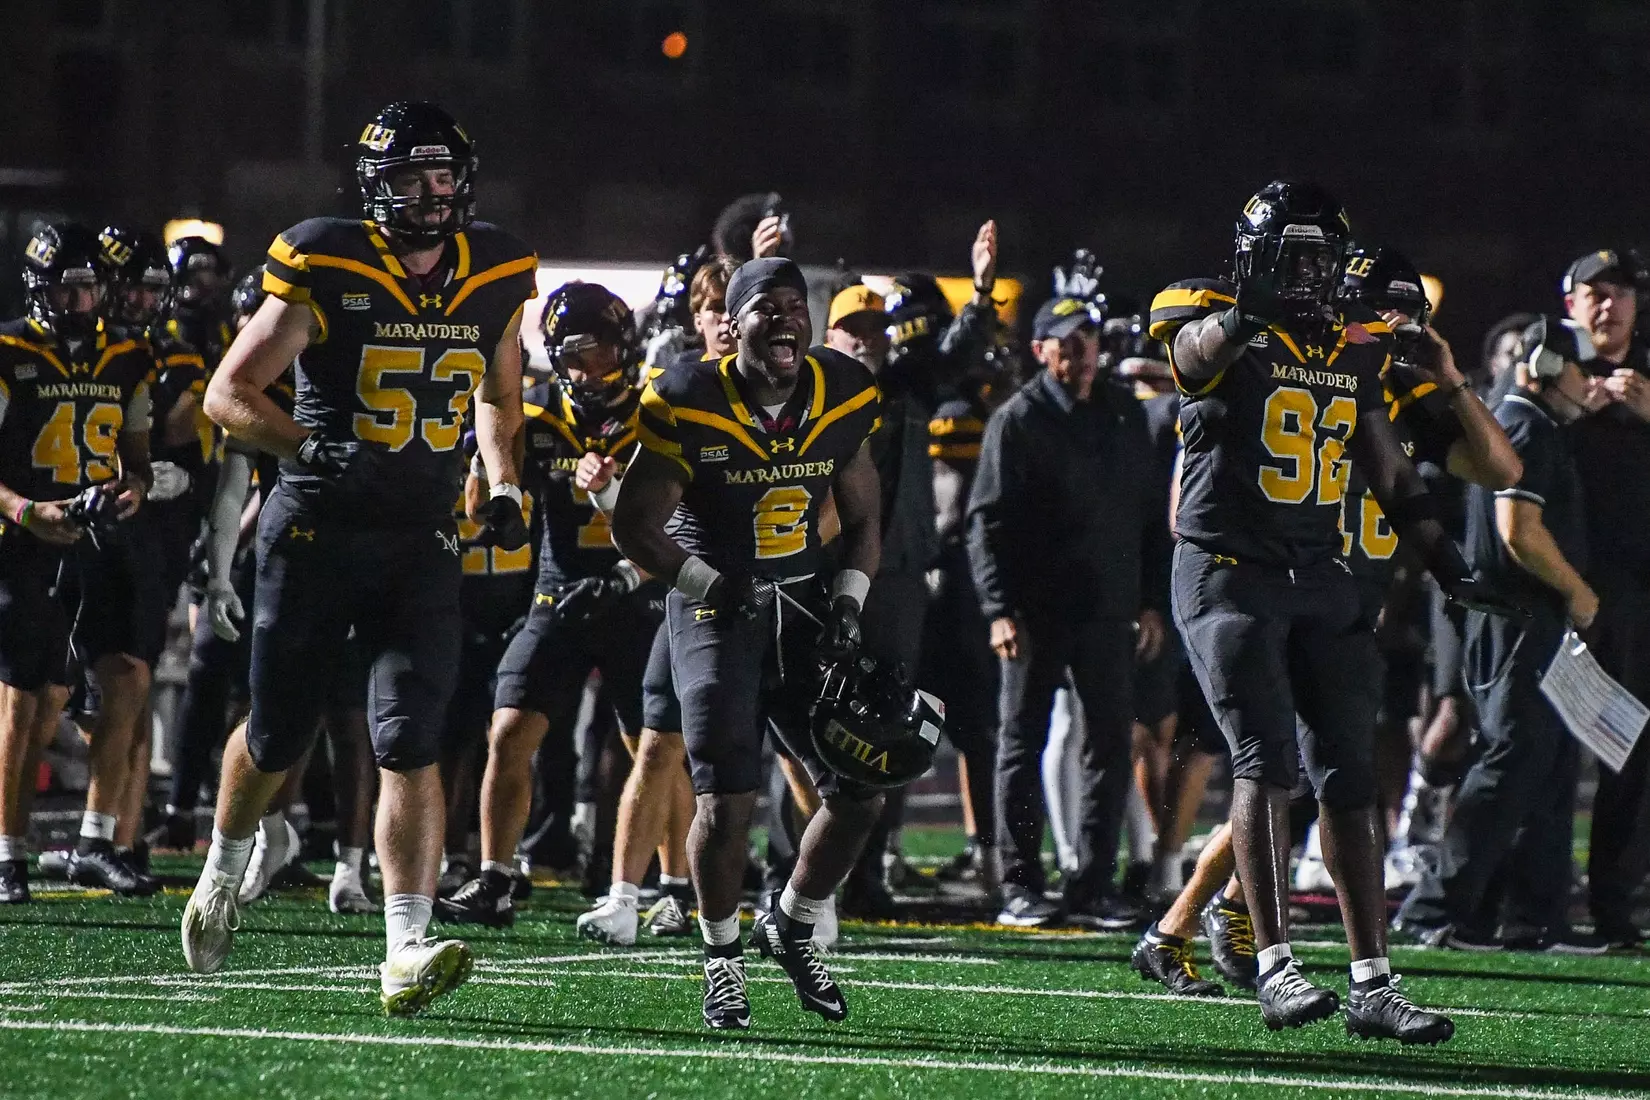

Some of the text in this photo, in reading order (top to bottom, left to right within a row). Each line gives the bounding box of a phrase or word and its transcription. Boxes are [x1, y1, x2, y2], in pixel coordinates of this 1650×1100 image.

[374, 322, 480, 342] MARAUDERS
[352, 344, 487, 453] 53
[1270, 362, 1358, 392] MARAUDERS
[31, 401, 123, 485] 49
[724, 459, 834, 484] MARAUDERS
[1258, 385, 1357, 506] 92
[752, 485, 813, 560] 2
